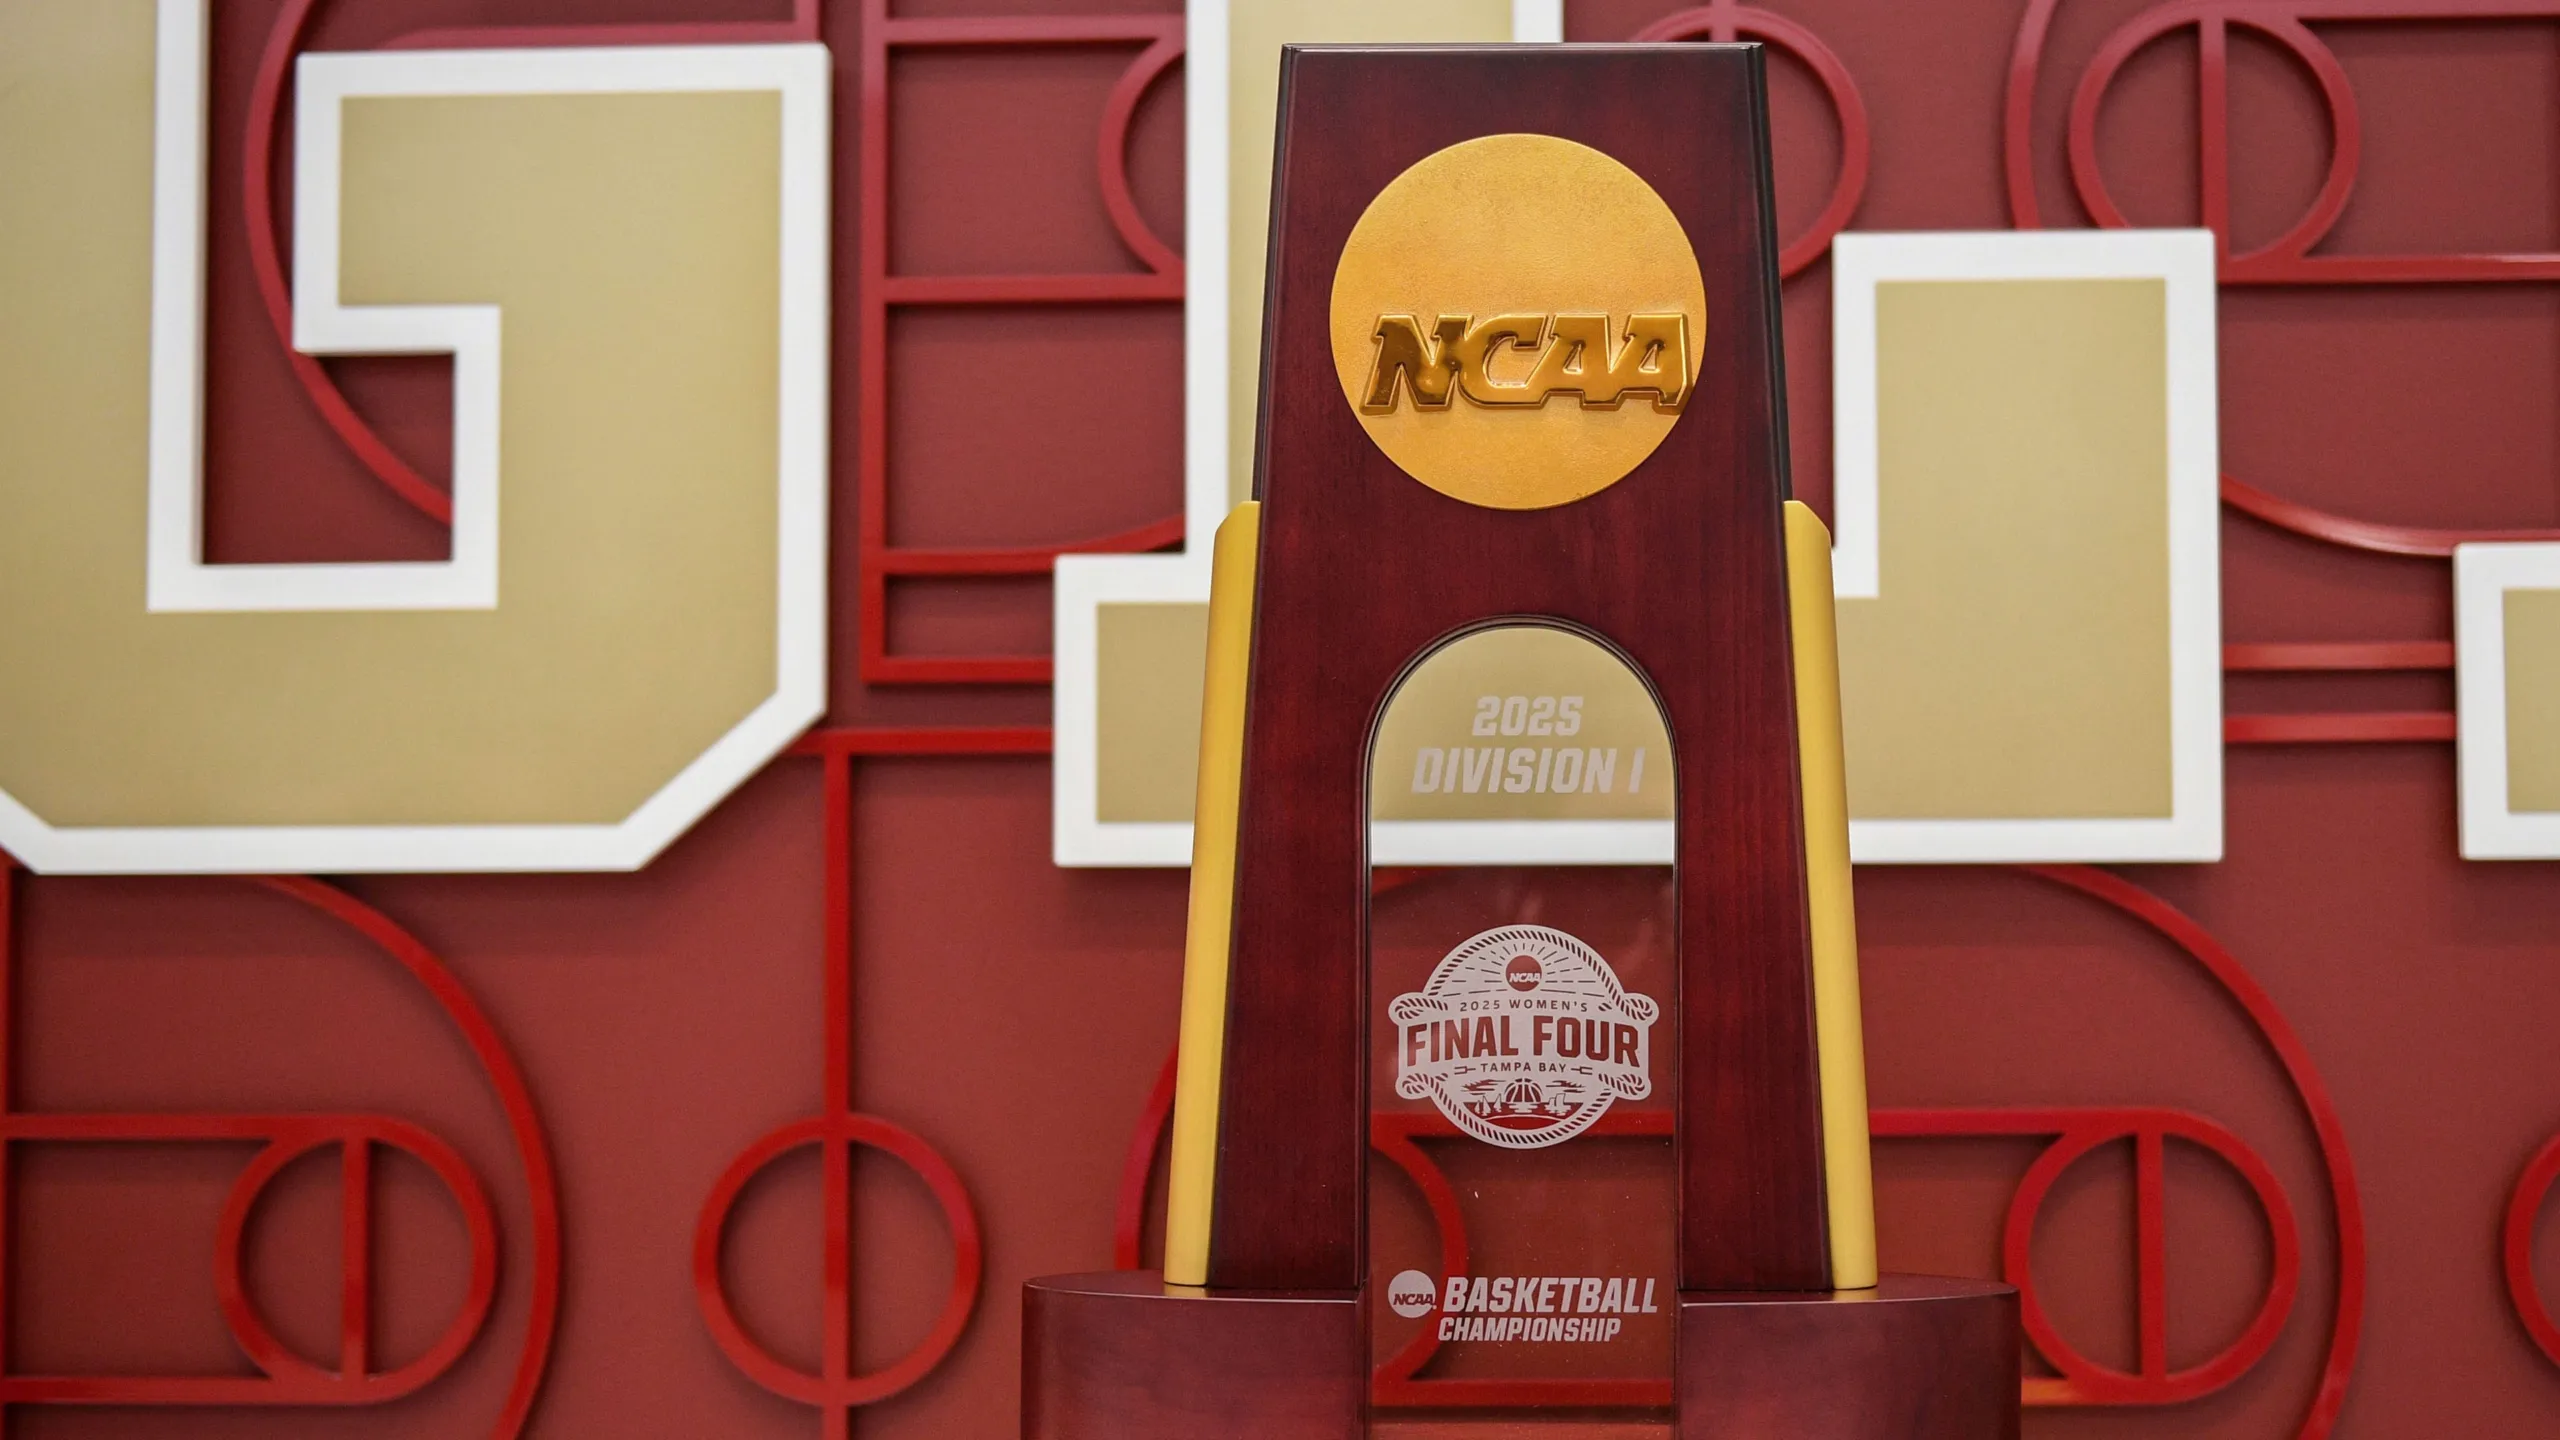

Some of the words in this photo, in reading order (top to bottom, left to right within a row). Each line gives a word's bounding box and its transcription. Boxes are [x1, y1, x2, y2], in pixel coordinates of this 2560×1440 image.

[1360, 312, 1692, 416] NCAA
[1472, 695, 1584, 737] 2025
[1411, 747, 1617, 794] DIVISION
[1628, 747, 1646, 794] I
[1508, 972, 1542, 984] NCAA
[1459, 999, 1501, 1012] 2025
[1508, 998, 1588, 1013] WOMEN'S
[1406, 1015, 1519, 1067] FINAL
[1533, 1015, 1641, 1068] FOUR
[1480, 1061, 1532, 1073] TAMPA
[1538, 1062, 1567, 1073] BAY
[1392, 1293, 1435, 1306] NCAA
[1442, 1276, 1658, 1313] BASKETBALL
[1438, 1317, 1622, 1342] CHAMPIONSHIP
